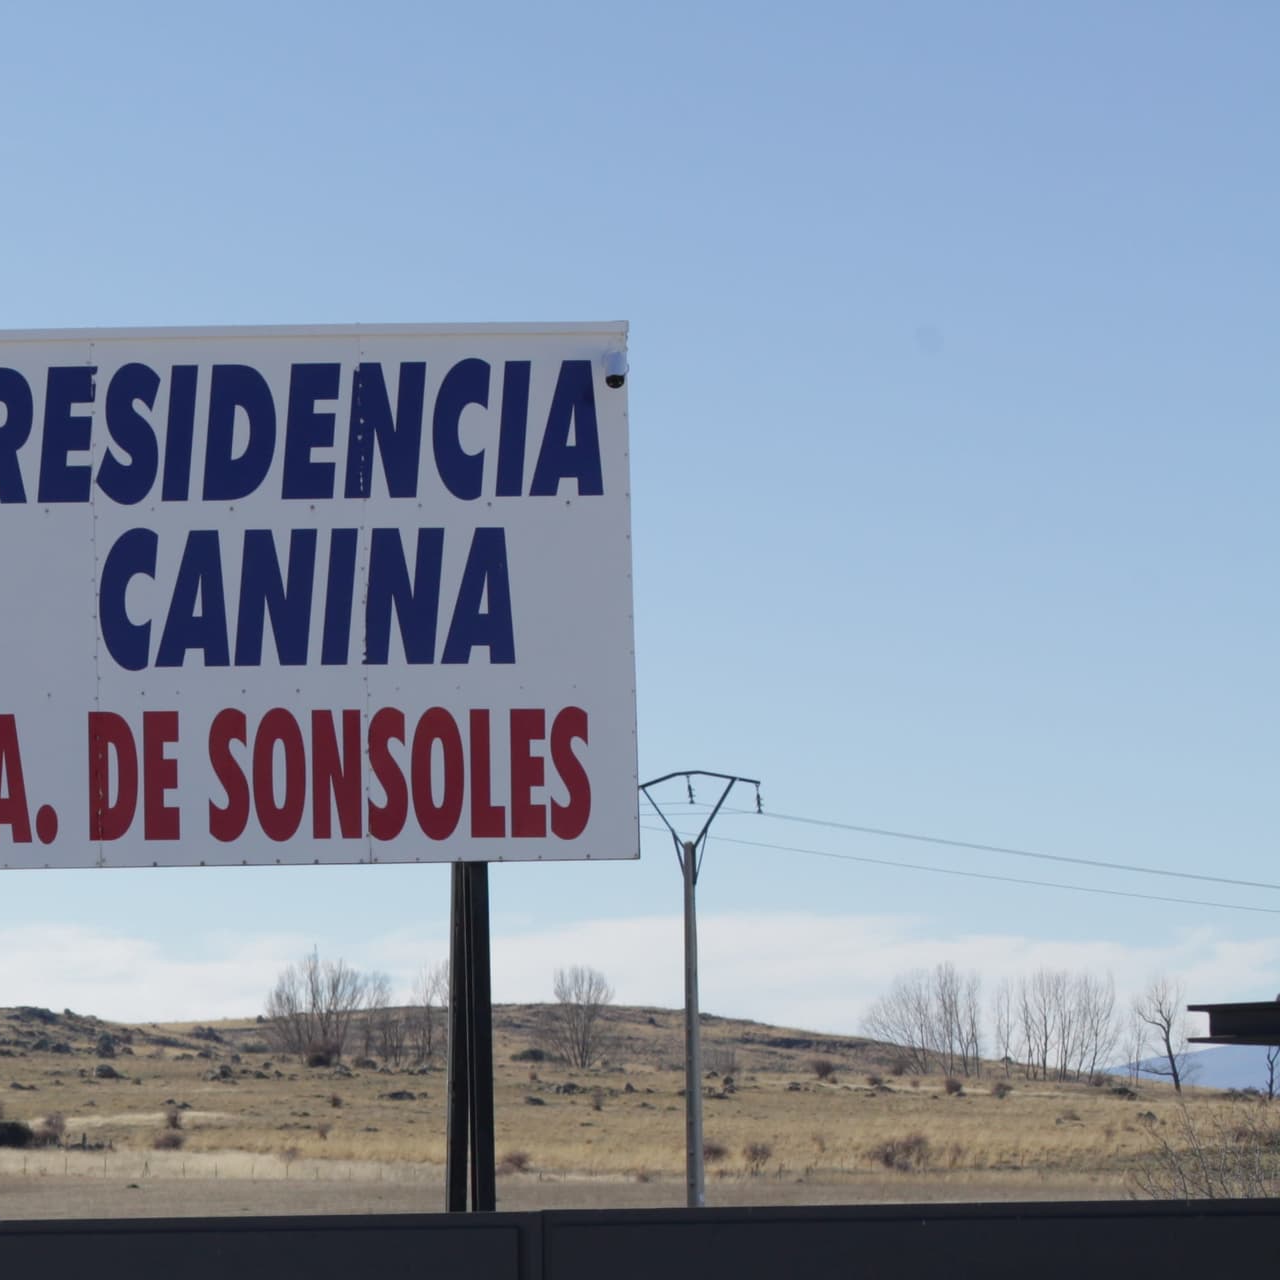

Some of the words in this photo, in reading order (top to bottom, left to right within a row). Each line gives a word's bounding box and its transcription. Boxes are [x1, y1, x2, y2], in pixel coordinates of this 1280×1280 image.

[99, 526, 516, 671] CANINA
[88, 710, 181, 841] DE
[208, 706, 591, 843] SONSOLES
